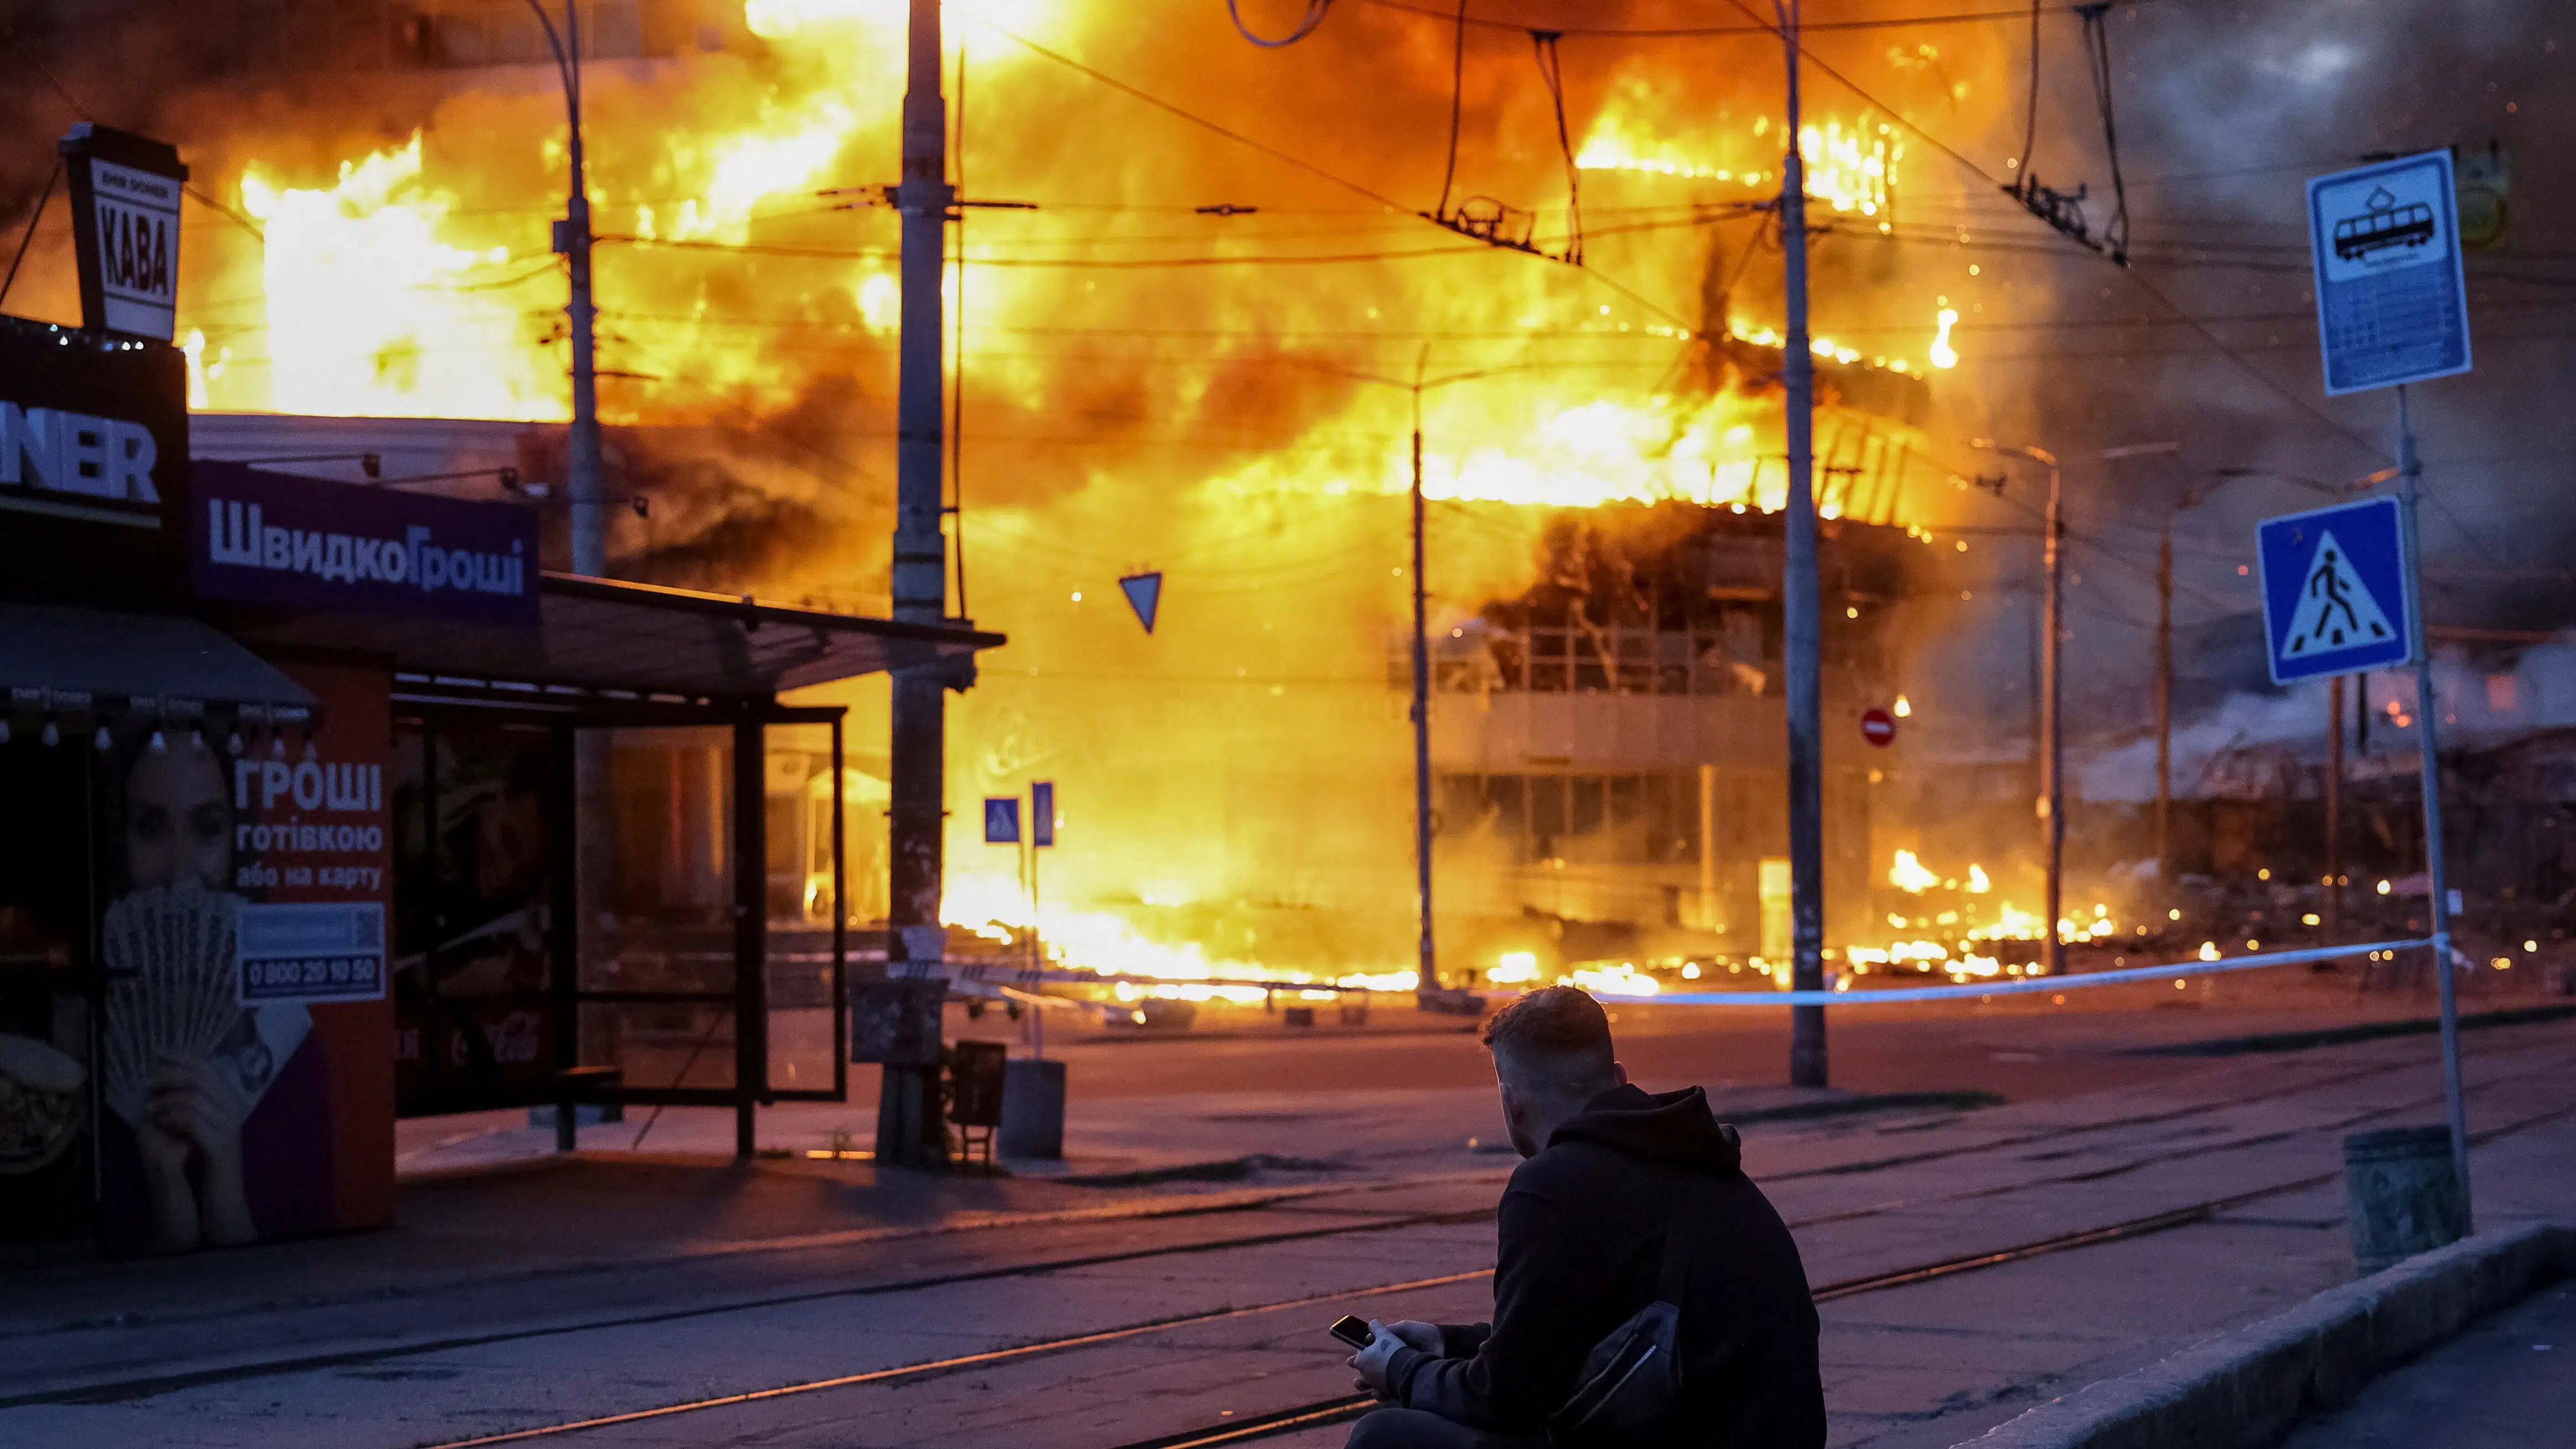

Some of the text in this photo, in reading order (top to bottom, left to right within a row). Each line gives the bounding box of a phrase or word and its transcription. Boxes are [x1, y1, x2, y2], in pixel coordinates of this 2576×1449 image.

[101, 204, 168, 295] КАВА
[209, 497, 523, 596] ШвидкоГроші
[235, 759, 382, 811] ГРОШІ
[235, 815, 383, 852] готівкою
[236, 860, 383, 892] або на карту
[249, 960, 263, 986] 0
